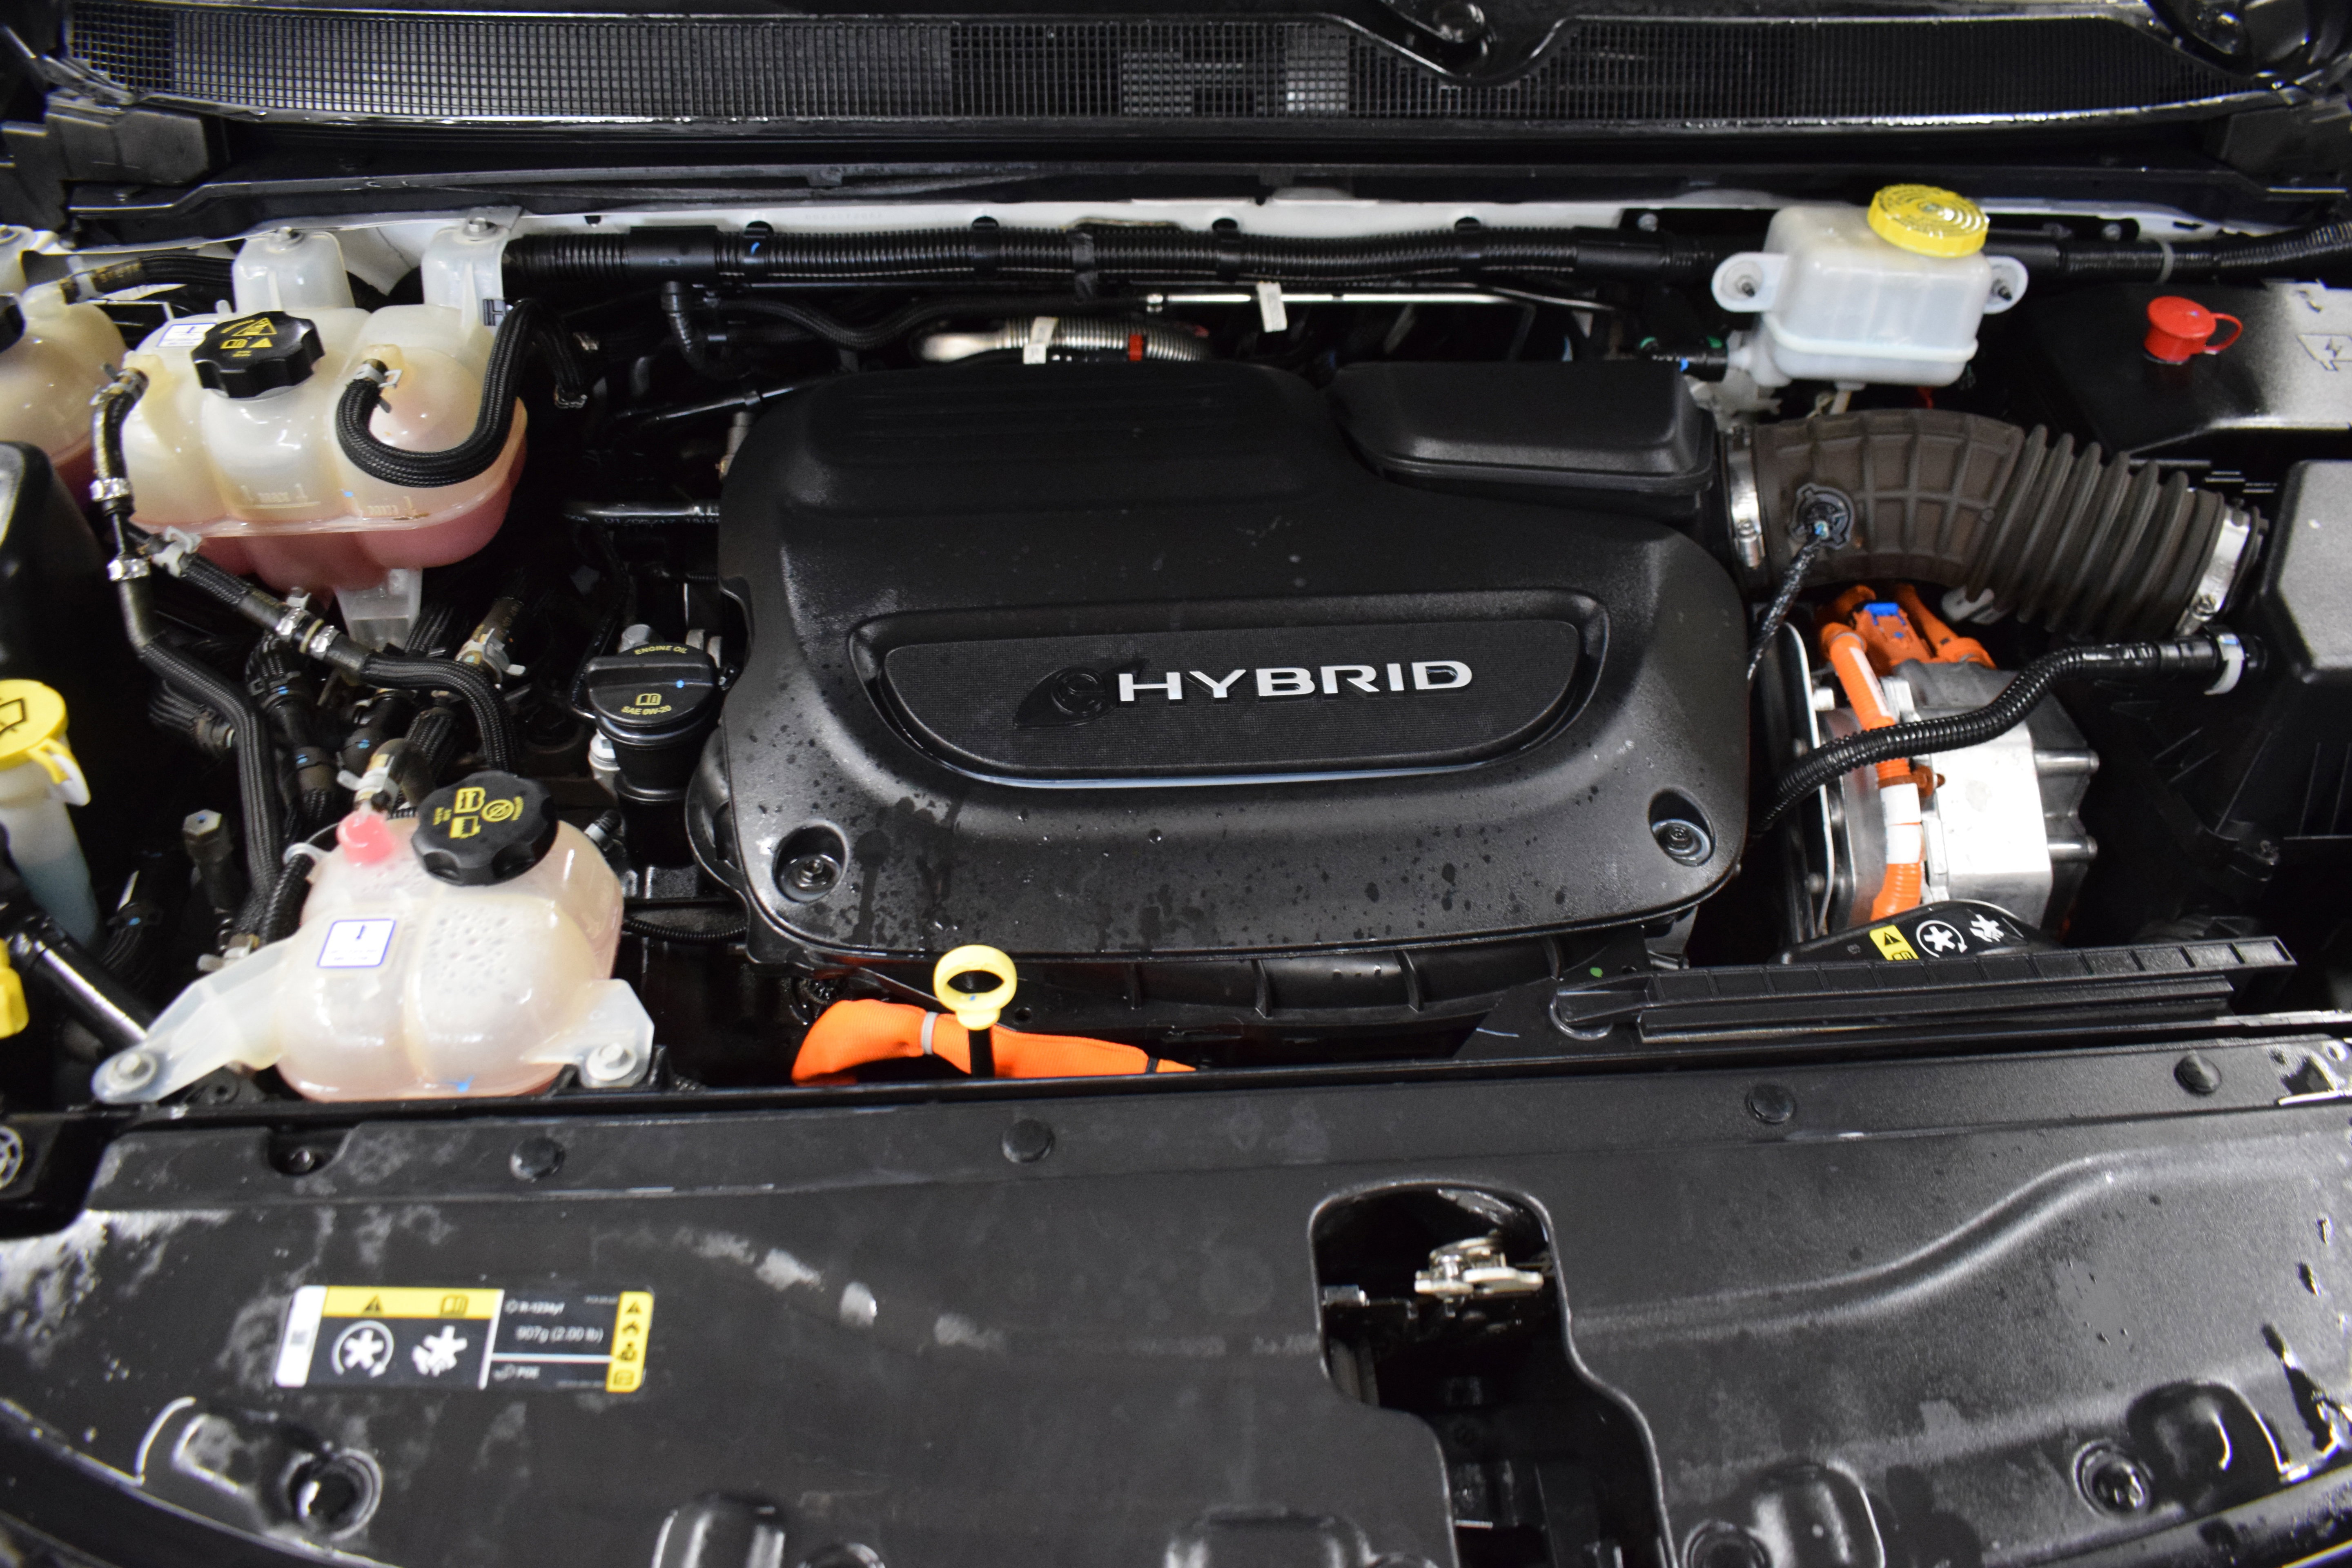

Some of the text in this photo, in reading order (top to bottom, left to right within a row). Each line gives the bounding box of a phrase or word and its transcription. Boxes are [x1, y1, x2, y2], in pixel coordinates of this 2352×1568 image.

[634, 645, 688, 655] ENGINE OIL
[1118, 660, 1473, 702] HYBRID
[621, 705, 672, 715] SAE 0W-20
[515, 1325, 549, 1343] 907g
[585, 1327, 604, 1343] lb)
